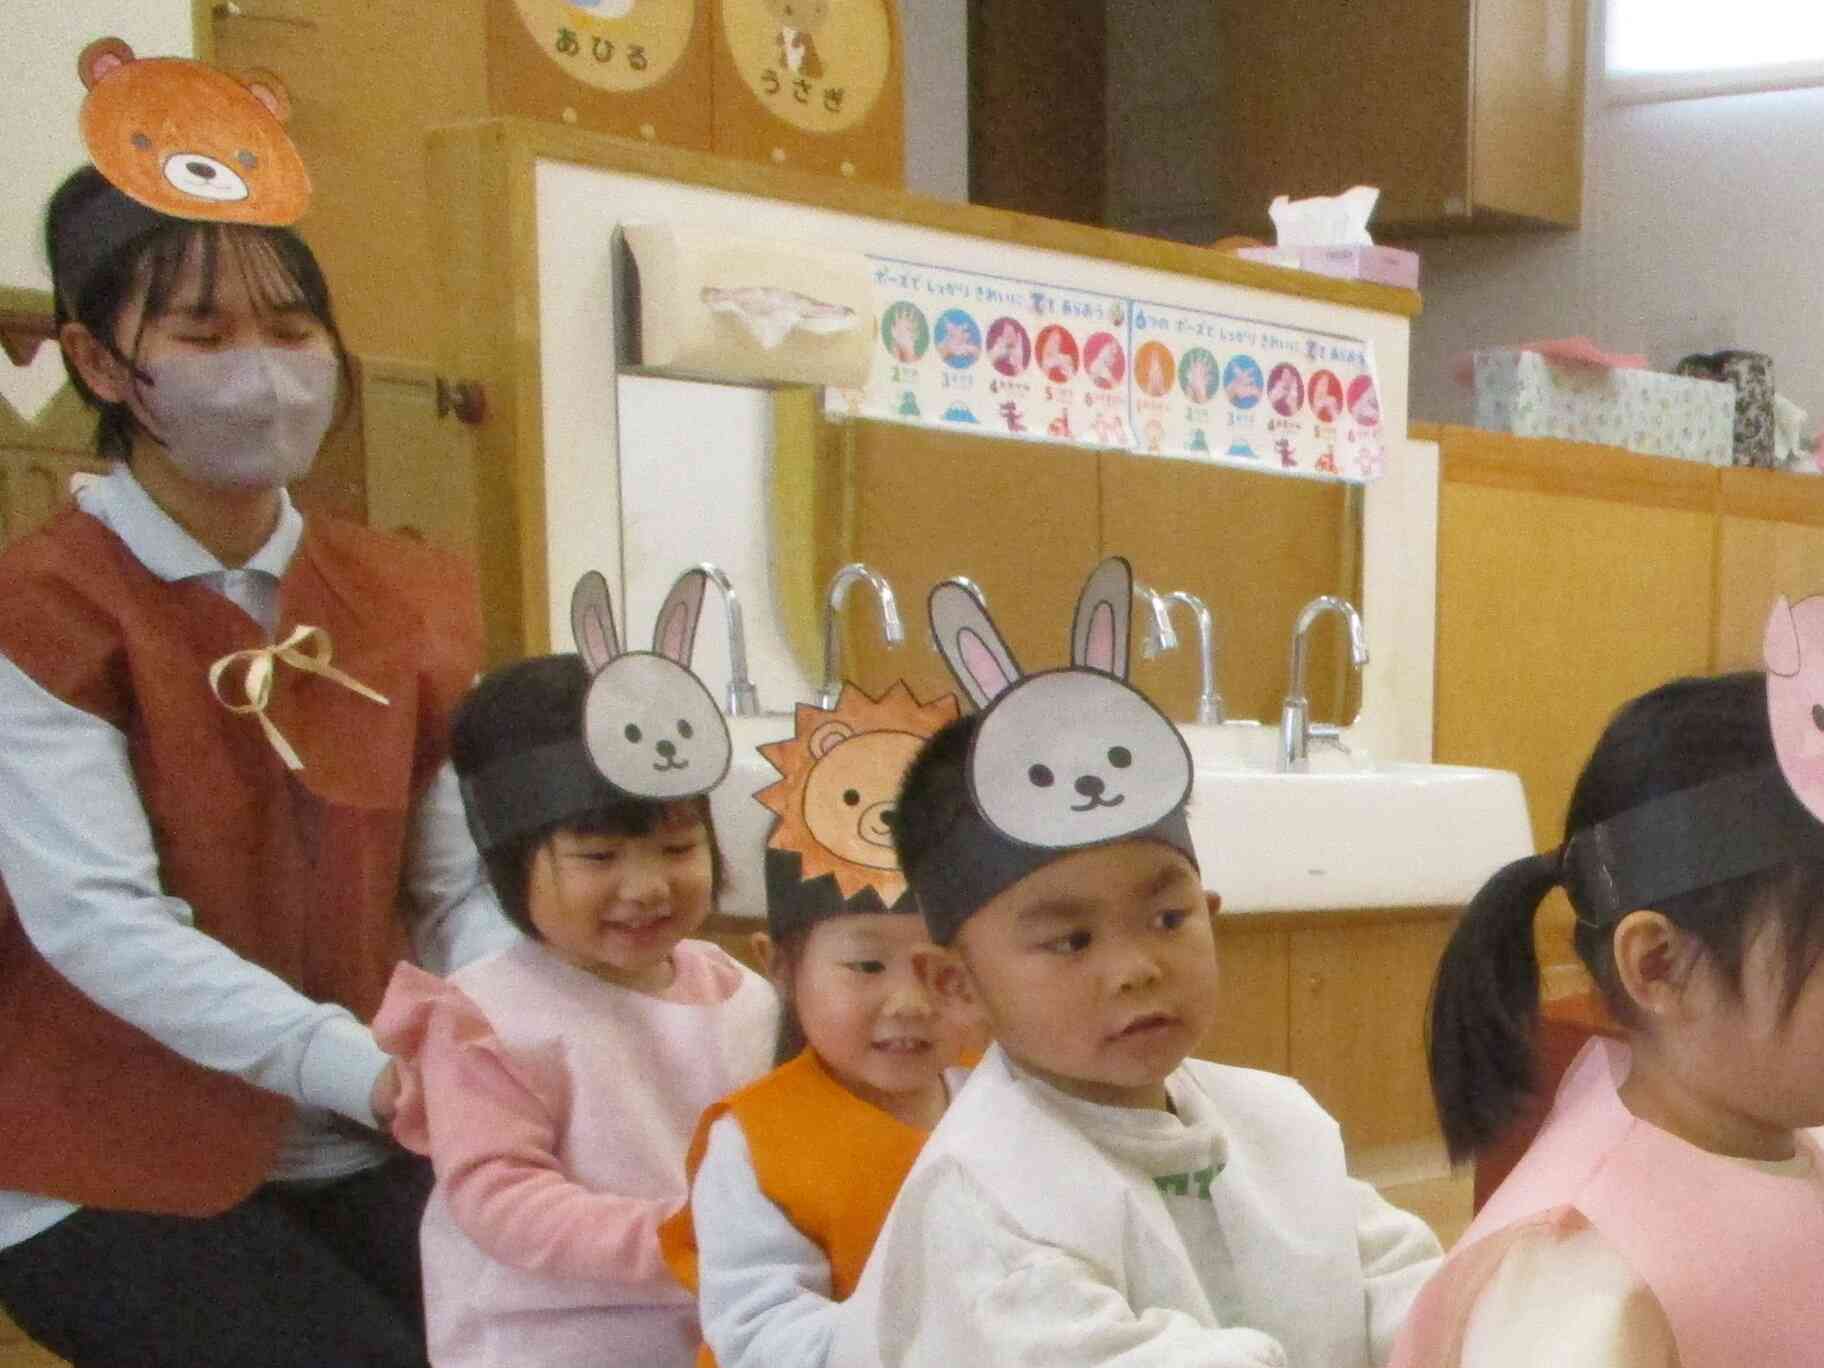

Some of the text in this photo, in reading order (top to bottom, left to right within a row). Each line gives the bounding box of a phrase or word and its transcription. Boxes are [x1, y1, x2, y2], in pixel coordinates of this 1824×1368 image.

[556, 28, 648, 71] あひる
[761, 68, 845, 113] うさぎ
